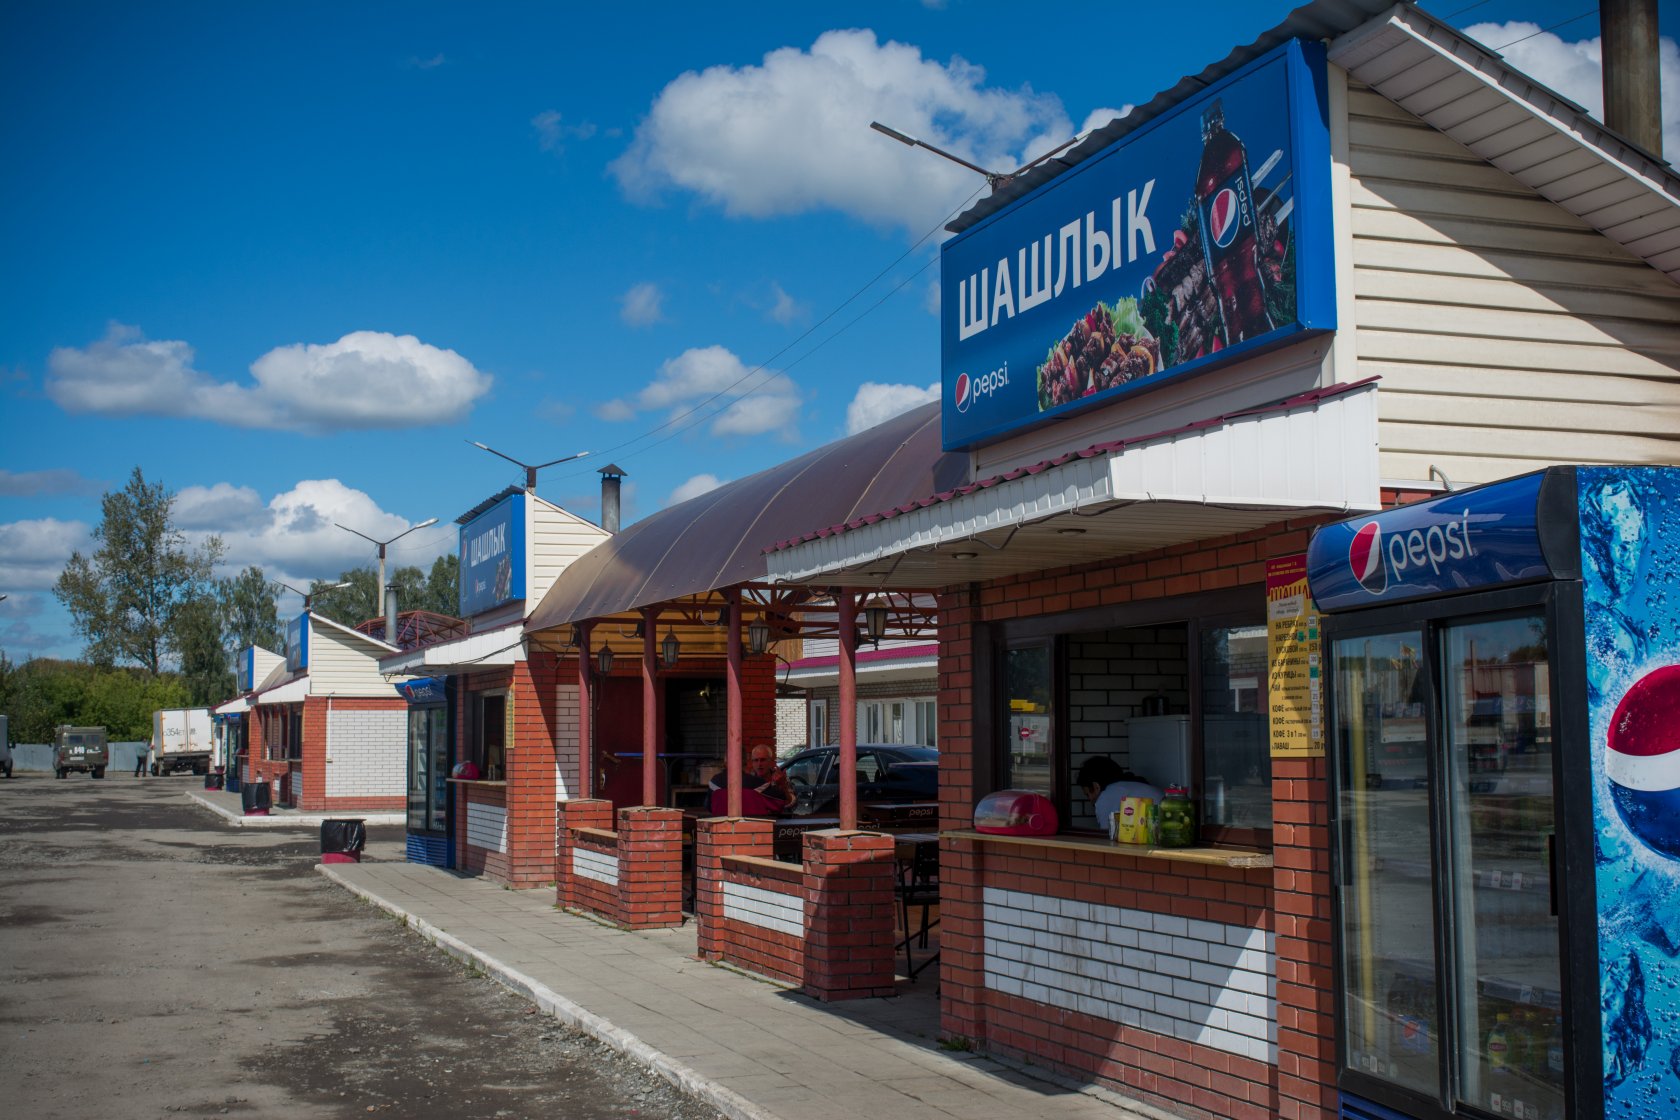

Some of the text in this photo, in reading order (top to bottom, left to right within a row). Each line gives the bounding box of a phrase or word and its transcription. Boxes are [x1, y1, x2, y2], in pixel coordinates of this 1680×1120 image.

[1235, 175, 1251, 227] pepsi
[959, 178, 1156, 342] ШАШЛЫК
[973, 361, 1008, 404] pepsi
[470, 522, 506, 567] ШАШЛЫК
[1389, 508, 1473, 582] pepsi
[908, 807, 934, 817] pepsi
